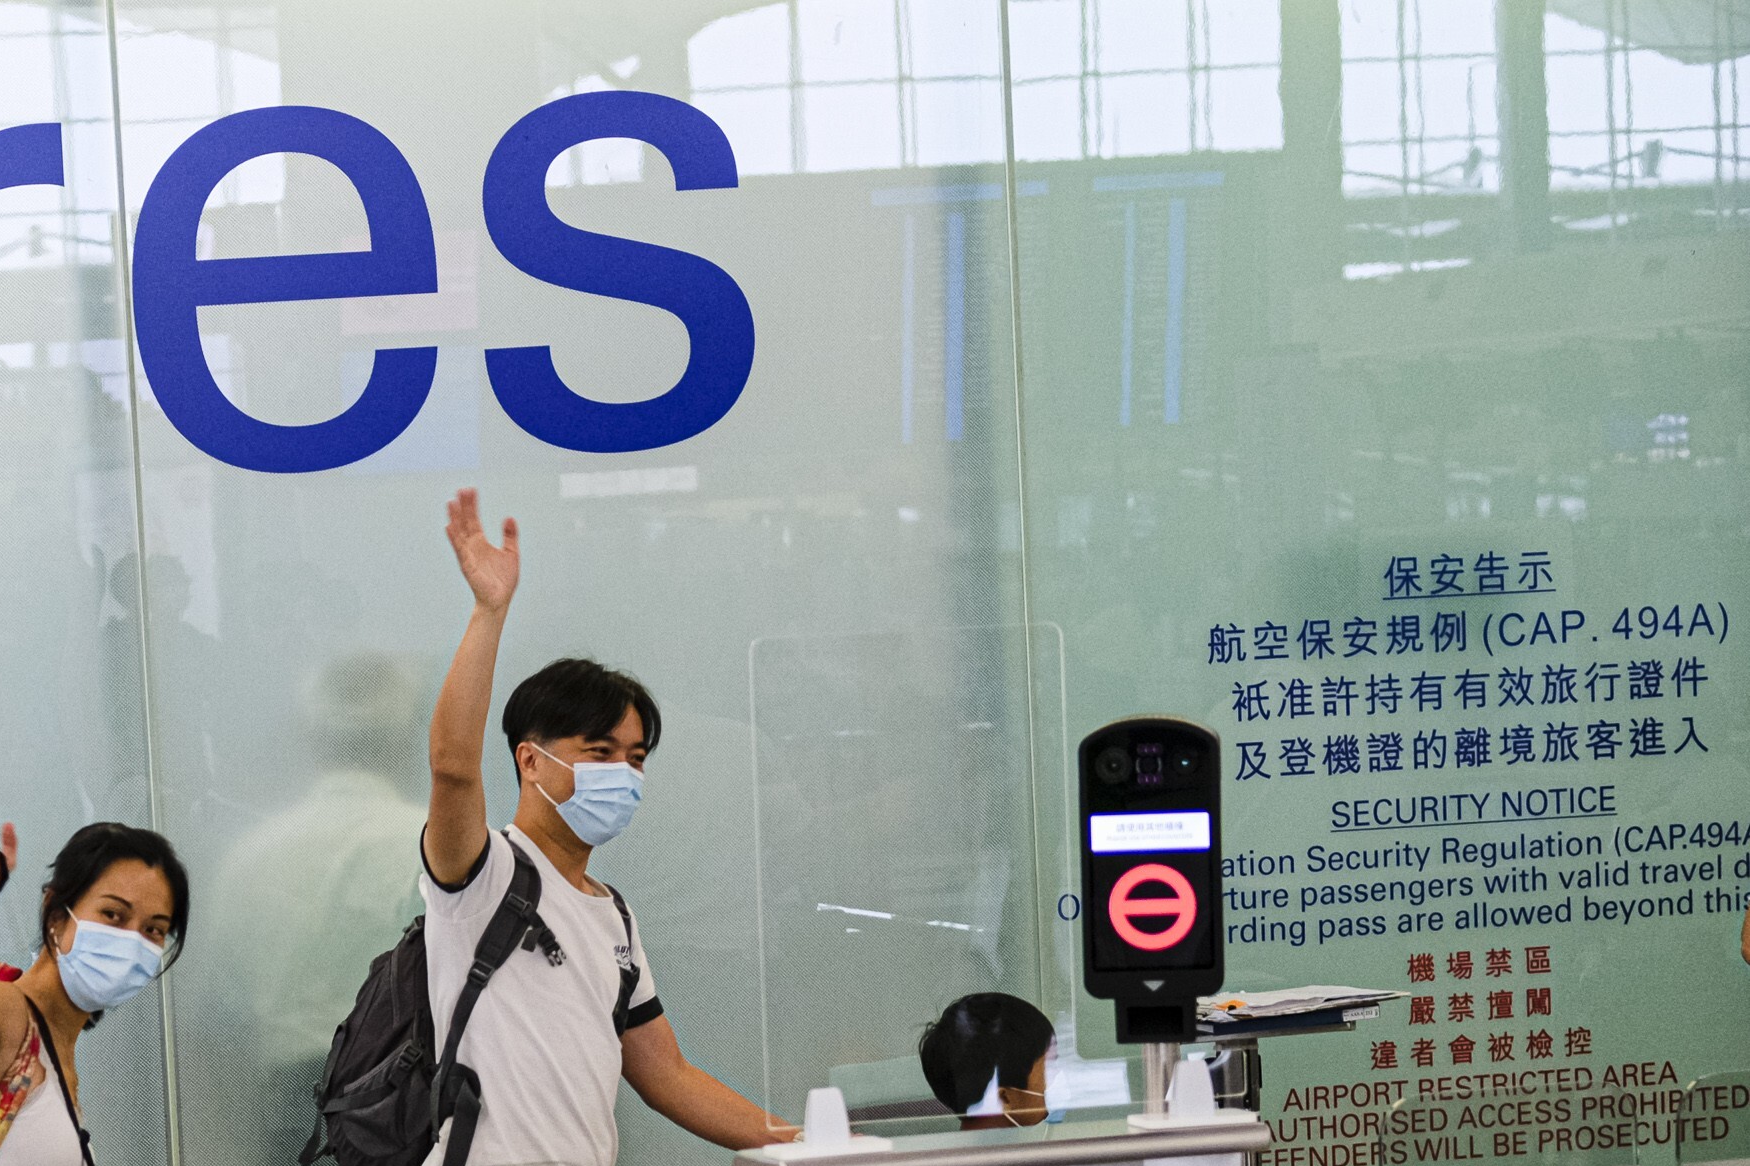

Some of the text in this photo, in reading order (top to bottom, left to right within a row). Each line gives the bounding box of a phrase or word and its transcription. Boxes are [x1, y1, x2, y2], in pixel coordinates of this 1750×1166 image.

[1383, 551, 1554, 597] 保安告示
[1207, 601, 1729, 666] 航空保安規例 (CAP. 494A)
[1234, 716, 1710, 782] 及登機證的離境旅客進入
[1331, 784, 1617, 828] SECURITY NOTICE
[1306, 840, 1431, 874] Security
[1441, 830, 1605, 872] Regulation
[1300, 876, 1474, 913] passengers
[1483, 865, 1548, 895] with
[1557, 859, 1630, 890] valid
[1638, 851, 1723, 884] travel
[1318, 915, 1387, 946] pass
[1396, 911, 1444, 935] are
[1454, 895, 1572, 931] allowed
[1583, 888, 1694, 926] beyond
[1406, 945, 1552, 984] 機場禁區
[1408, 987, 1552, 1026] 嚴禁擅闖
[1369, 1026, 1593, 1071] 違者會被檢控
[1282, 1060, 1679, 1113] AIRPORT RESTRICTED AREA
[1457, 1098, 1572, 1130] ACCESS
[1580, 1083, 1749, 1121] PROHIBITED
[1413, 1134, 1484, 1162] WILL
[1493, 1130, 1528, 1158] BE
[1537, 1116, 1730, 1154] PROSECUTED
